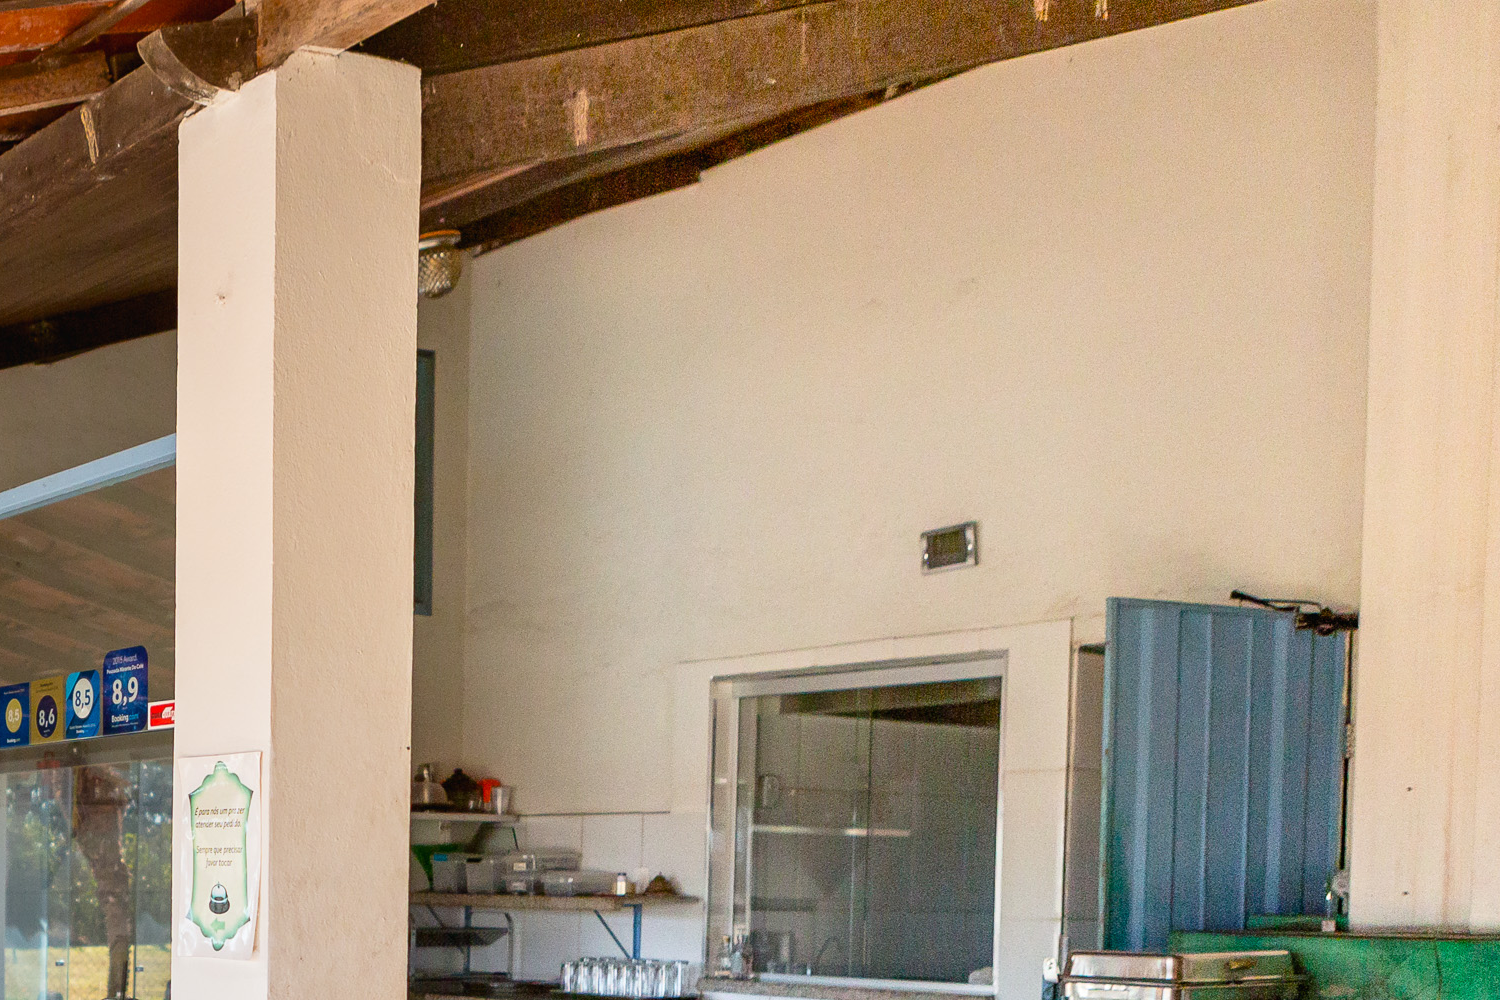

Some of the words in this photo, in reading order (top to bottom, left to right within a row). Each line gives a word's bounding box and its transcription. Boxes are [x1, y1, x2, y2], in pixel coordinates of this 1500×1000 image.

[112, 676, 139, 706] 8,9
[74, 689, 91, 709] 8,5
[7, 708, 20, 723] 8,5
[38, 708, 55, 728] 8,6
[198, 808, 210, 817] para
[196, 845, 213, 856] Sempre
[213, 847, 223, 855] que
[205, 857, 218, 868] favor
[218, 859, 233, 867] tocar
